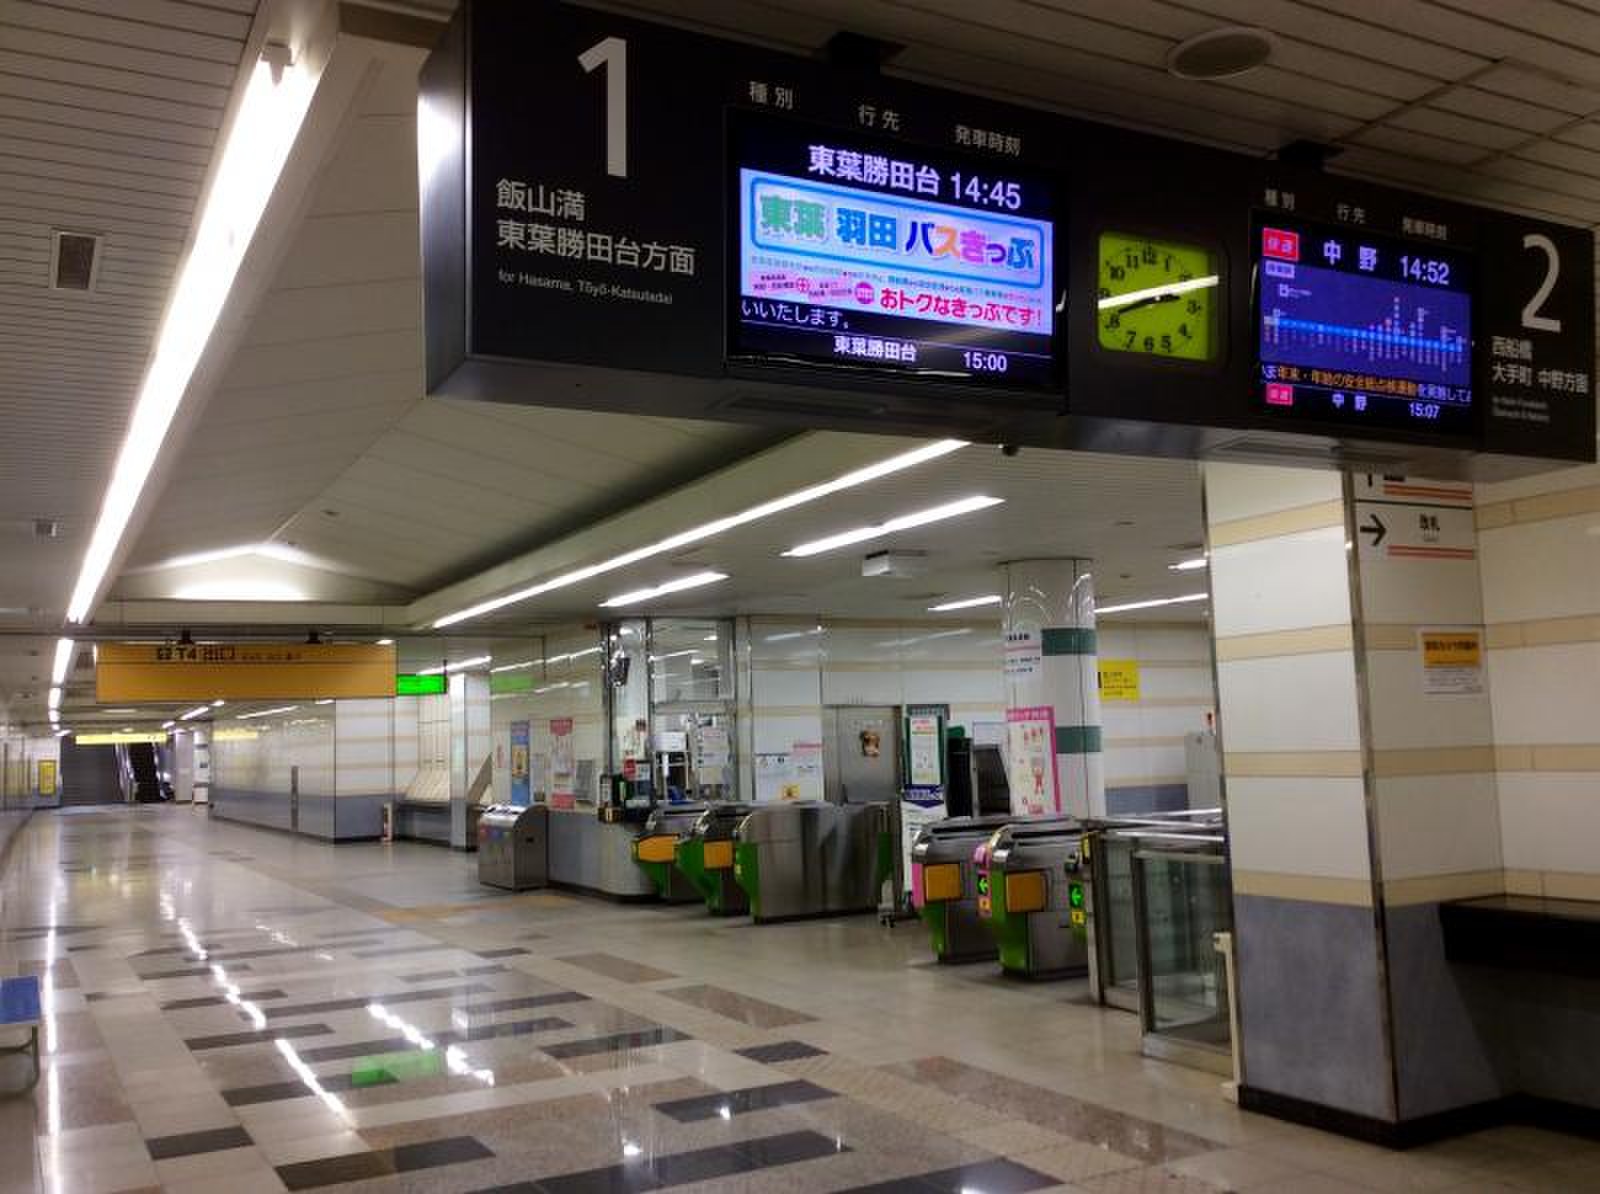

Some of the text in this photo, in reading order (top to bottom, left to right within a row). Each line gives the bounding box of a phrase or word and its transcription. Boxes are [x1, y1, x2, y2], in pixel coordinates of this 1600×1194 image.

[577, 36, 627, 177] 1
[749, 80, 794, 110] 種別
[858, 104, 901, 131] 行先
[808, 145, 1022, 210] 東葉勝田台 14:45
[496, 178, 586, 222] 飯山満
[496, 219, 696, 275] 東葉勝田台方面
[836, 206, 898, 250] 羽田
[1322, 240, 1378, 271] 中野
[1400, 255, 1450, 286] 14:52
[1521, 233, 1562, 333] 2
[741, 301, 850, 329] いいたします。
[833, 335, 1008, 372] 東葉勝田台 15:00
[1492, 361, 1533, 387] 大手町
[1409, 402, 1441, 419] 15:07
